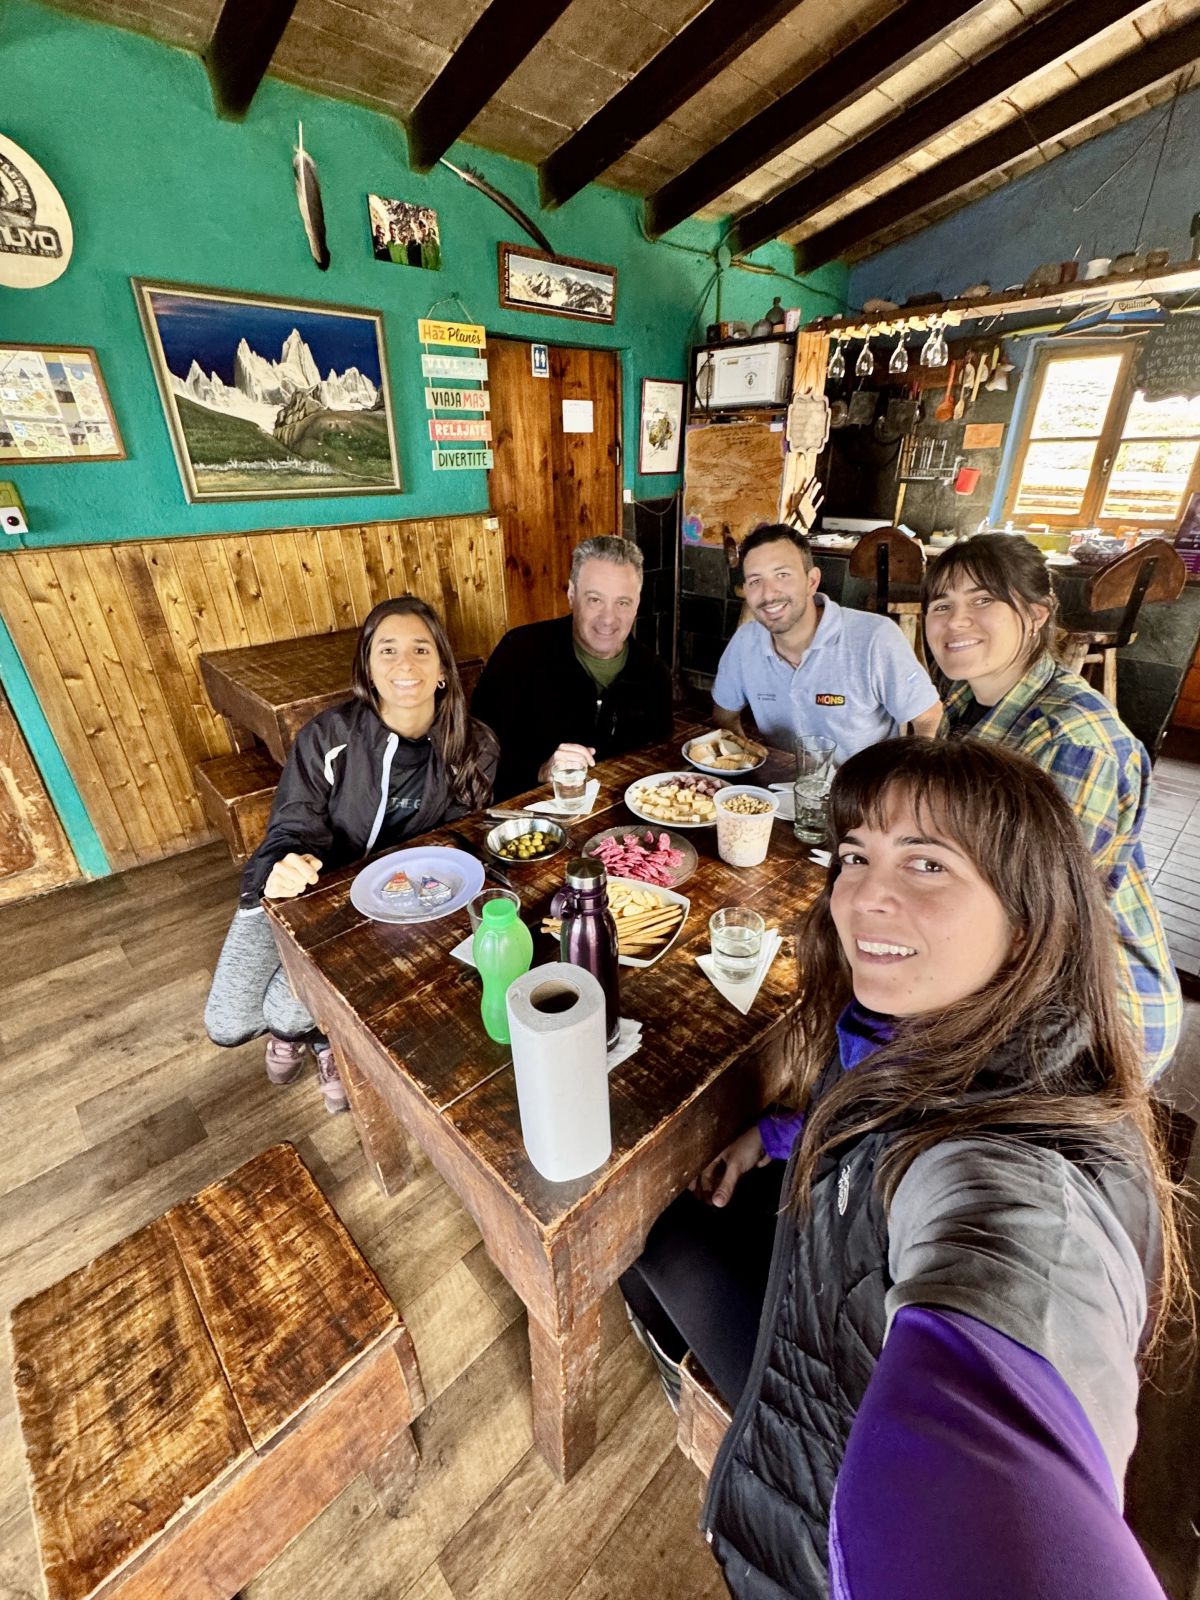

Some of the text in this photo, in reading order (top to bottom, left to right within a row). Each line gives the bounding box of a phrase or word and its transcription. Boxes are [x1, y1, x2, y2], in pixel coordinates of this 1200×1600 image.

[0, 226, 58, 252] UYO
[423, 325, 446, 340] Haz
[431, 391, 485, 408] VIAJA MAS
[434, 423, 488, 437] RELAJATE
[438, 452, 488, 467] DIVERTITE
[817, 695, 844, 704] MONS
